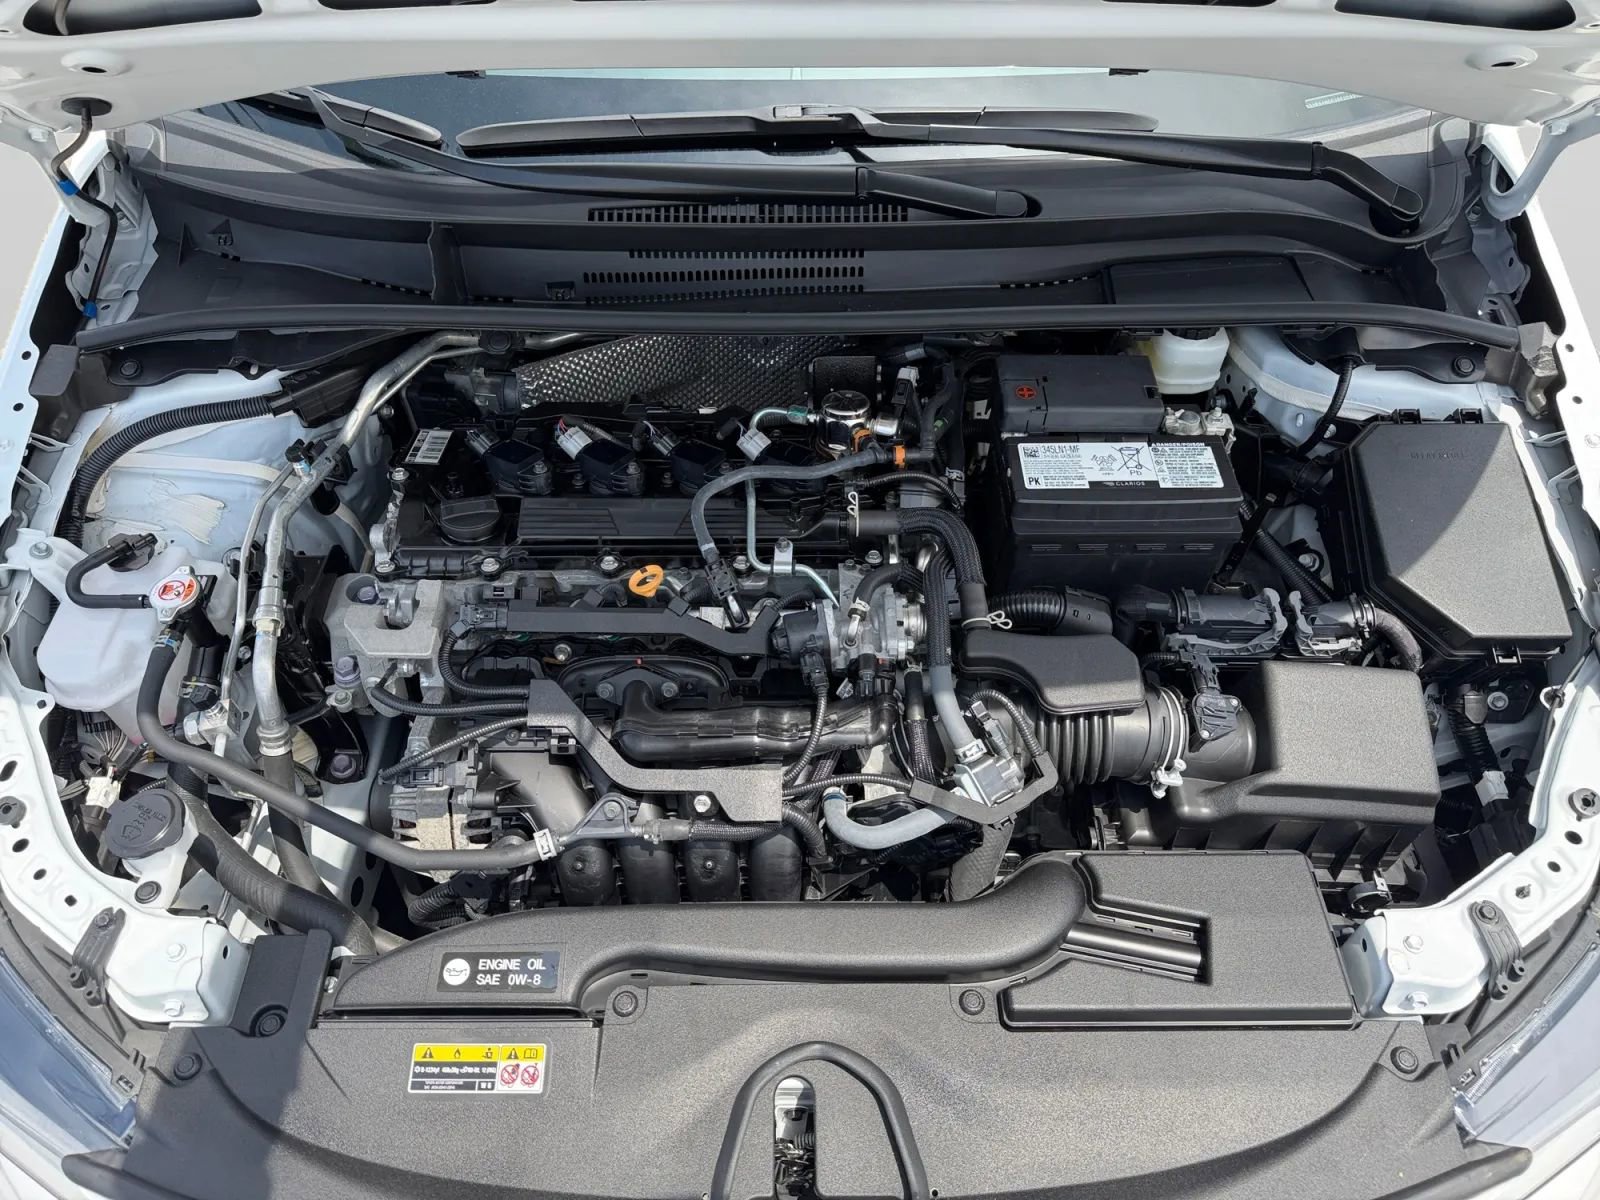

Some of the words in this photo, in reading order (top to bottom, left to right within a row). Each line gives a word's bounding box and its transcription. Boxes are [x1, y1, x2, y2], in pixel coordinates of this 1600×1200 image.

[1028, 476, 1041, 486] PK
[478, 958, 521, 970] ENGINE
[527, 958, 546, 970] OIL
[476, 973, 501, 985] SAE
[507, 973, 542, 985] 0W-8
